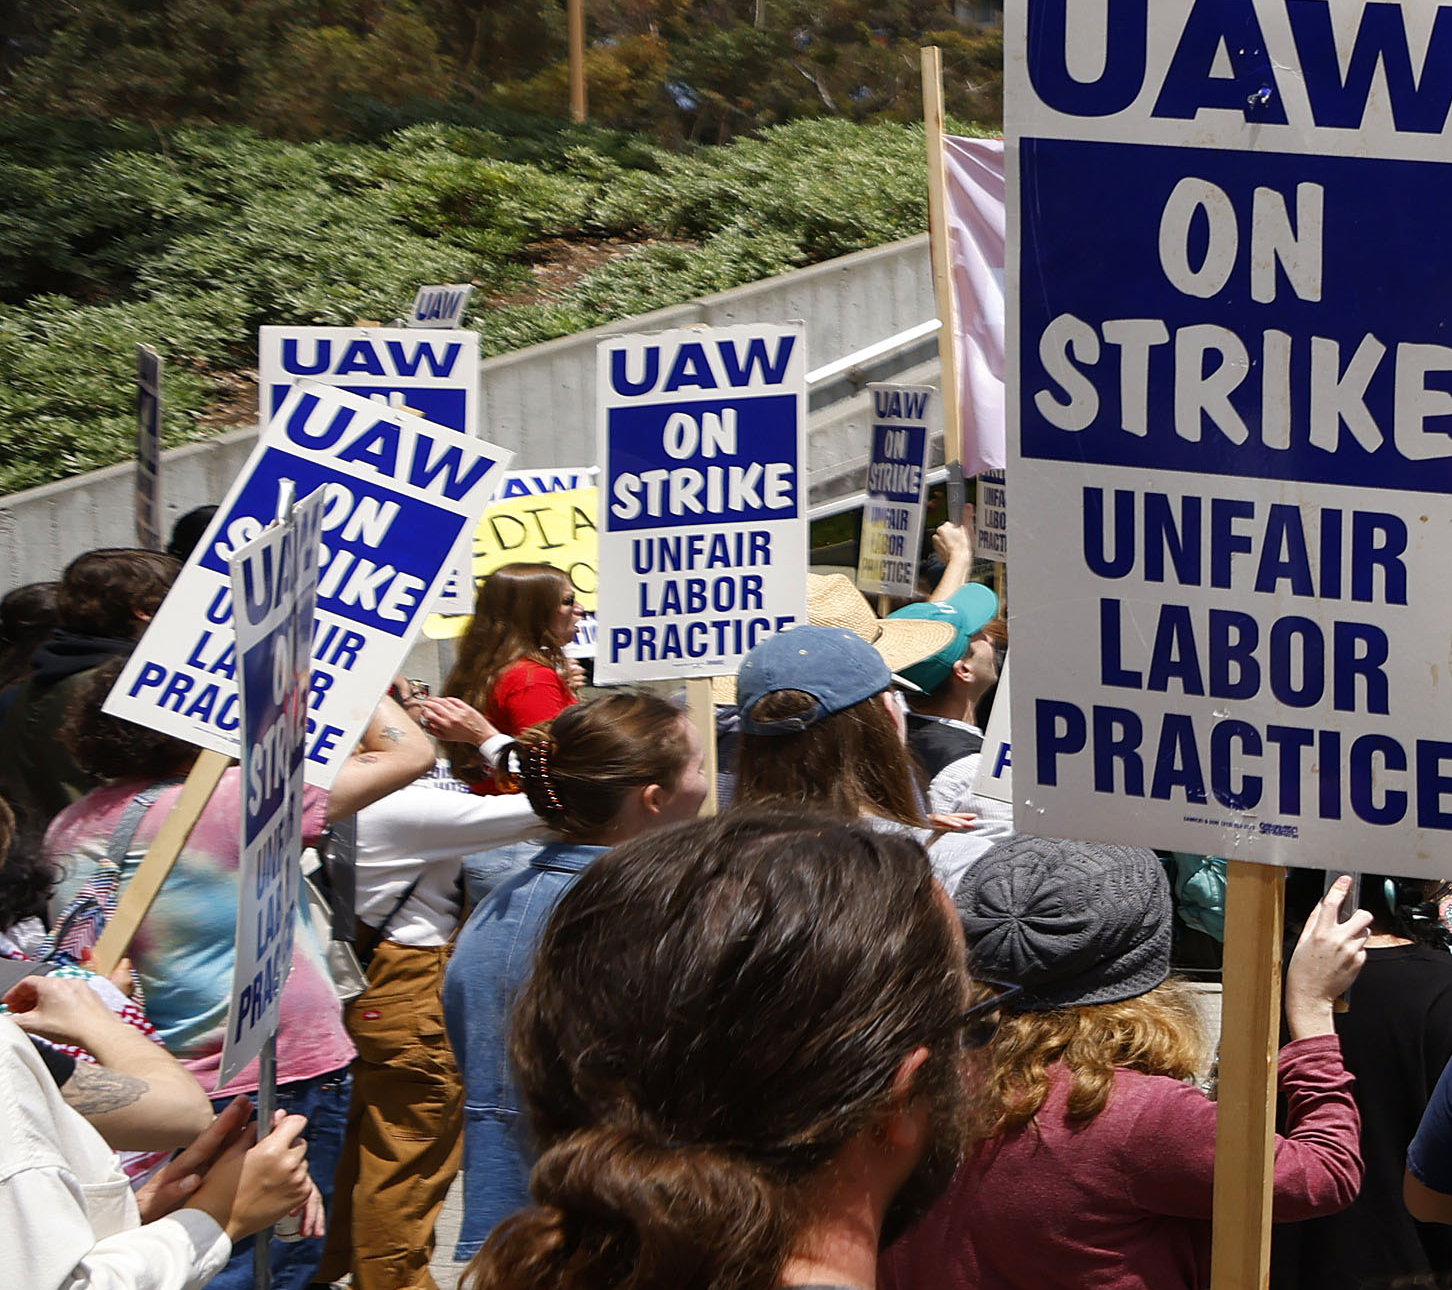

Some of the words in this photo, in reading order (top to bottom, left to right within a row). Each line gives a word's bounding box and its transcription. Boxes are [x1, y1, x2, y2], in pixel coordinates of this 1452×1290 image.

[1159, 176, 1324, 304] ON
[416, 291, 465, 321] UAW
[282, 338, 461, 377] UAW
[611, 336, 795, 396] UAW
[874, 391, 928, 419] UAW
[286, 394, 495, 501] UAW
[663, 408, 737, 459] ON
[884, 430, 906, 459] ON
[490, 476, 578, 500] AW
[612, 463, 793, 519] STRIKE
[869, 465, 920, 494] STRIKE
[986, 509, 1006, 529] LABO
[633, 531, 771, 574] UNFAIR
[1083, 487, 1409, 606] UNFAIR
[214, 517, 427, 622] SIKE
[640, 574, 763, 617] LABOR
[1100, 598, 1389, 714] LABOR
